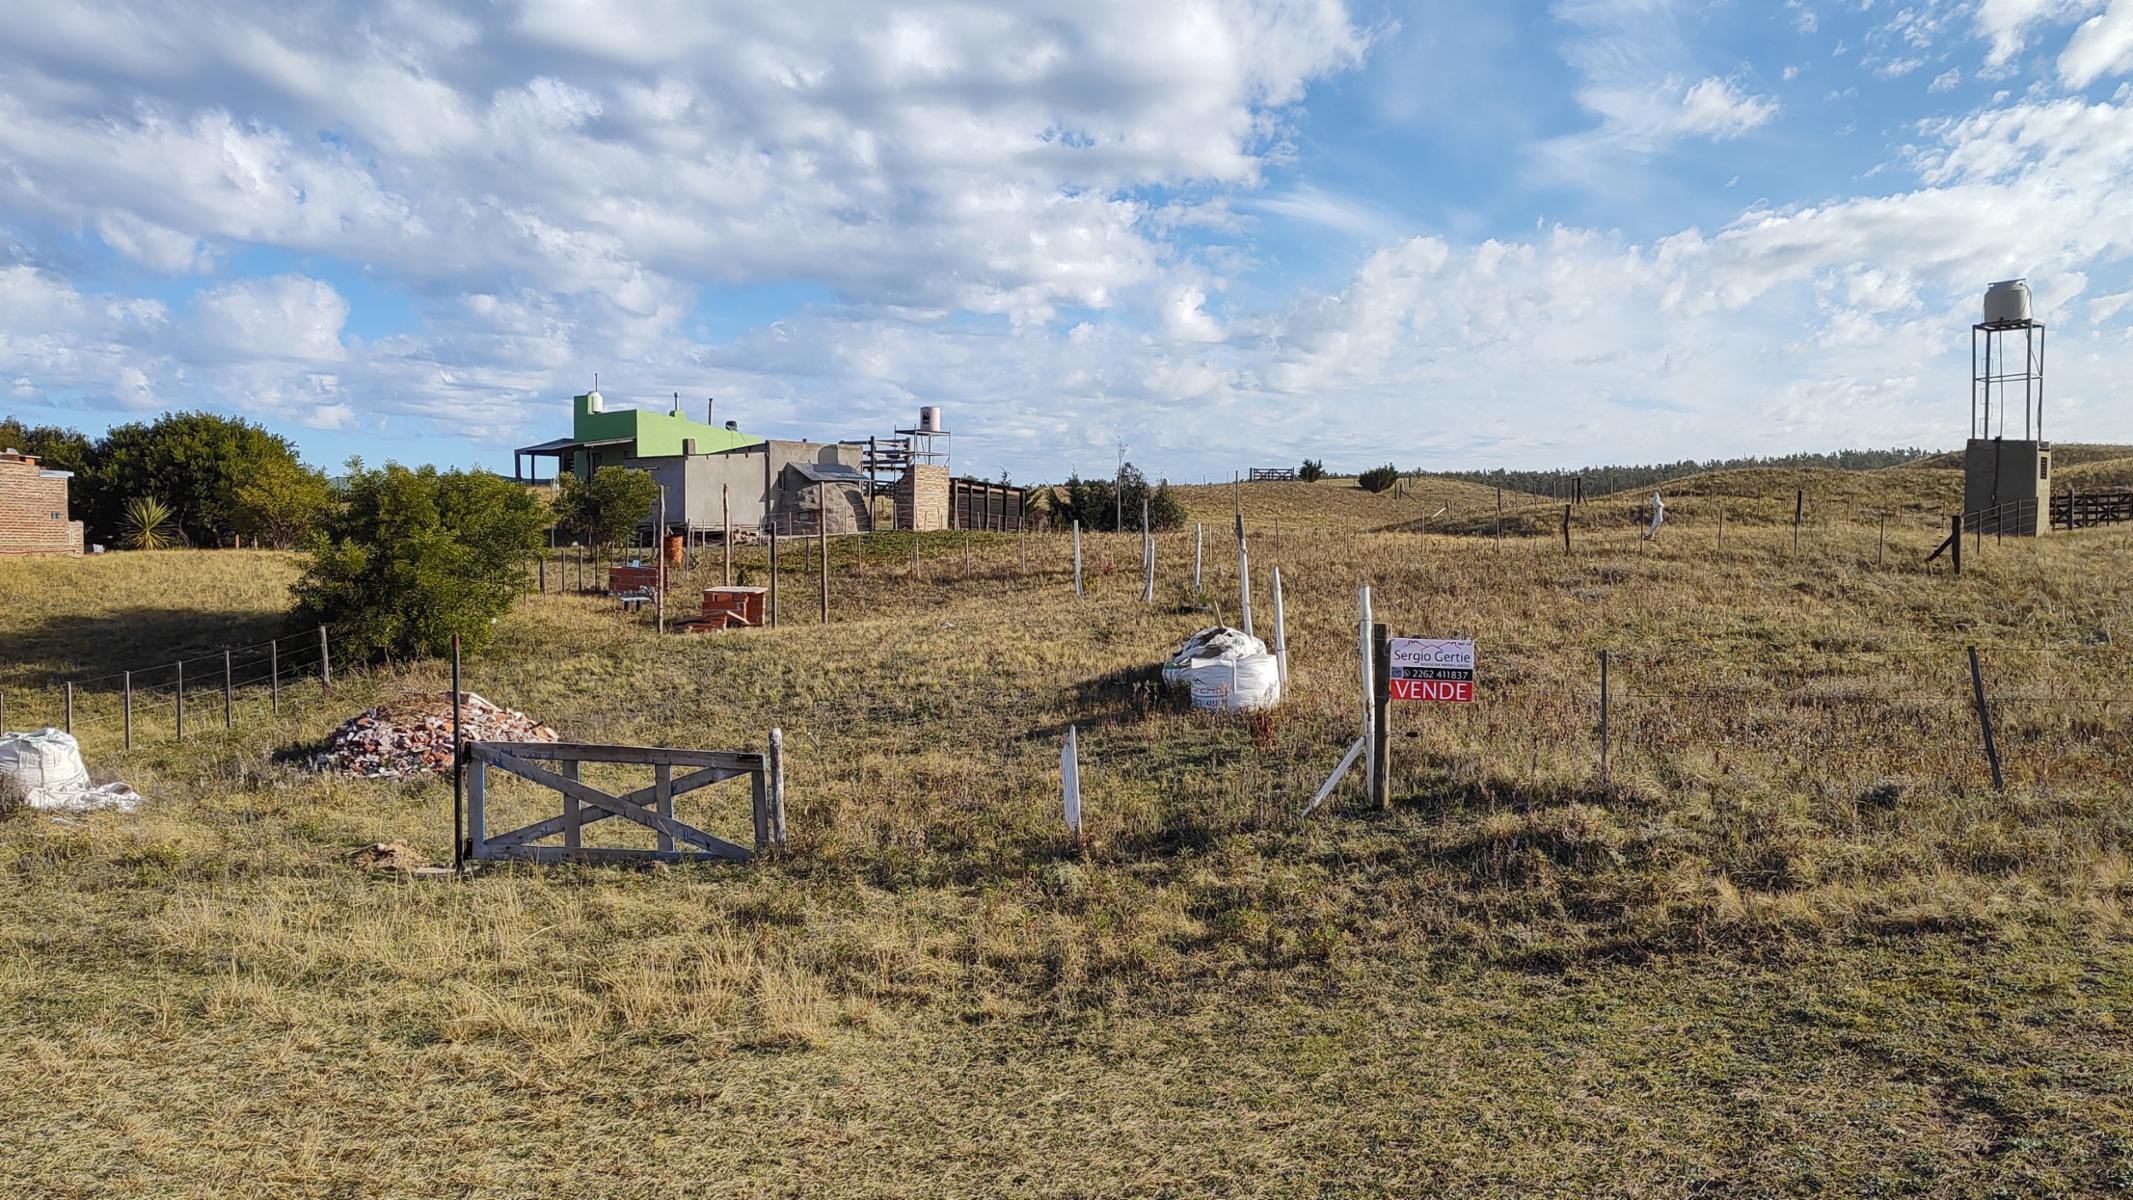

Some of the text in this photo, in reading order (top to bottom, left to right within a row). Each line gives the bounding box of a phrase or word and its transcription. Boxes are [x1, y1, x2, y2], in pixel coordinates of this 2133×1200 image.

[1394, 649, 1431, 664] Sergio
[1412, 669, 1468, 680] 2262 411837
[1395, 680, 1468, 700] VENDE
